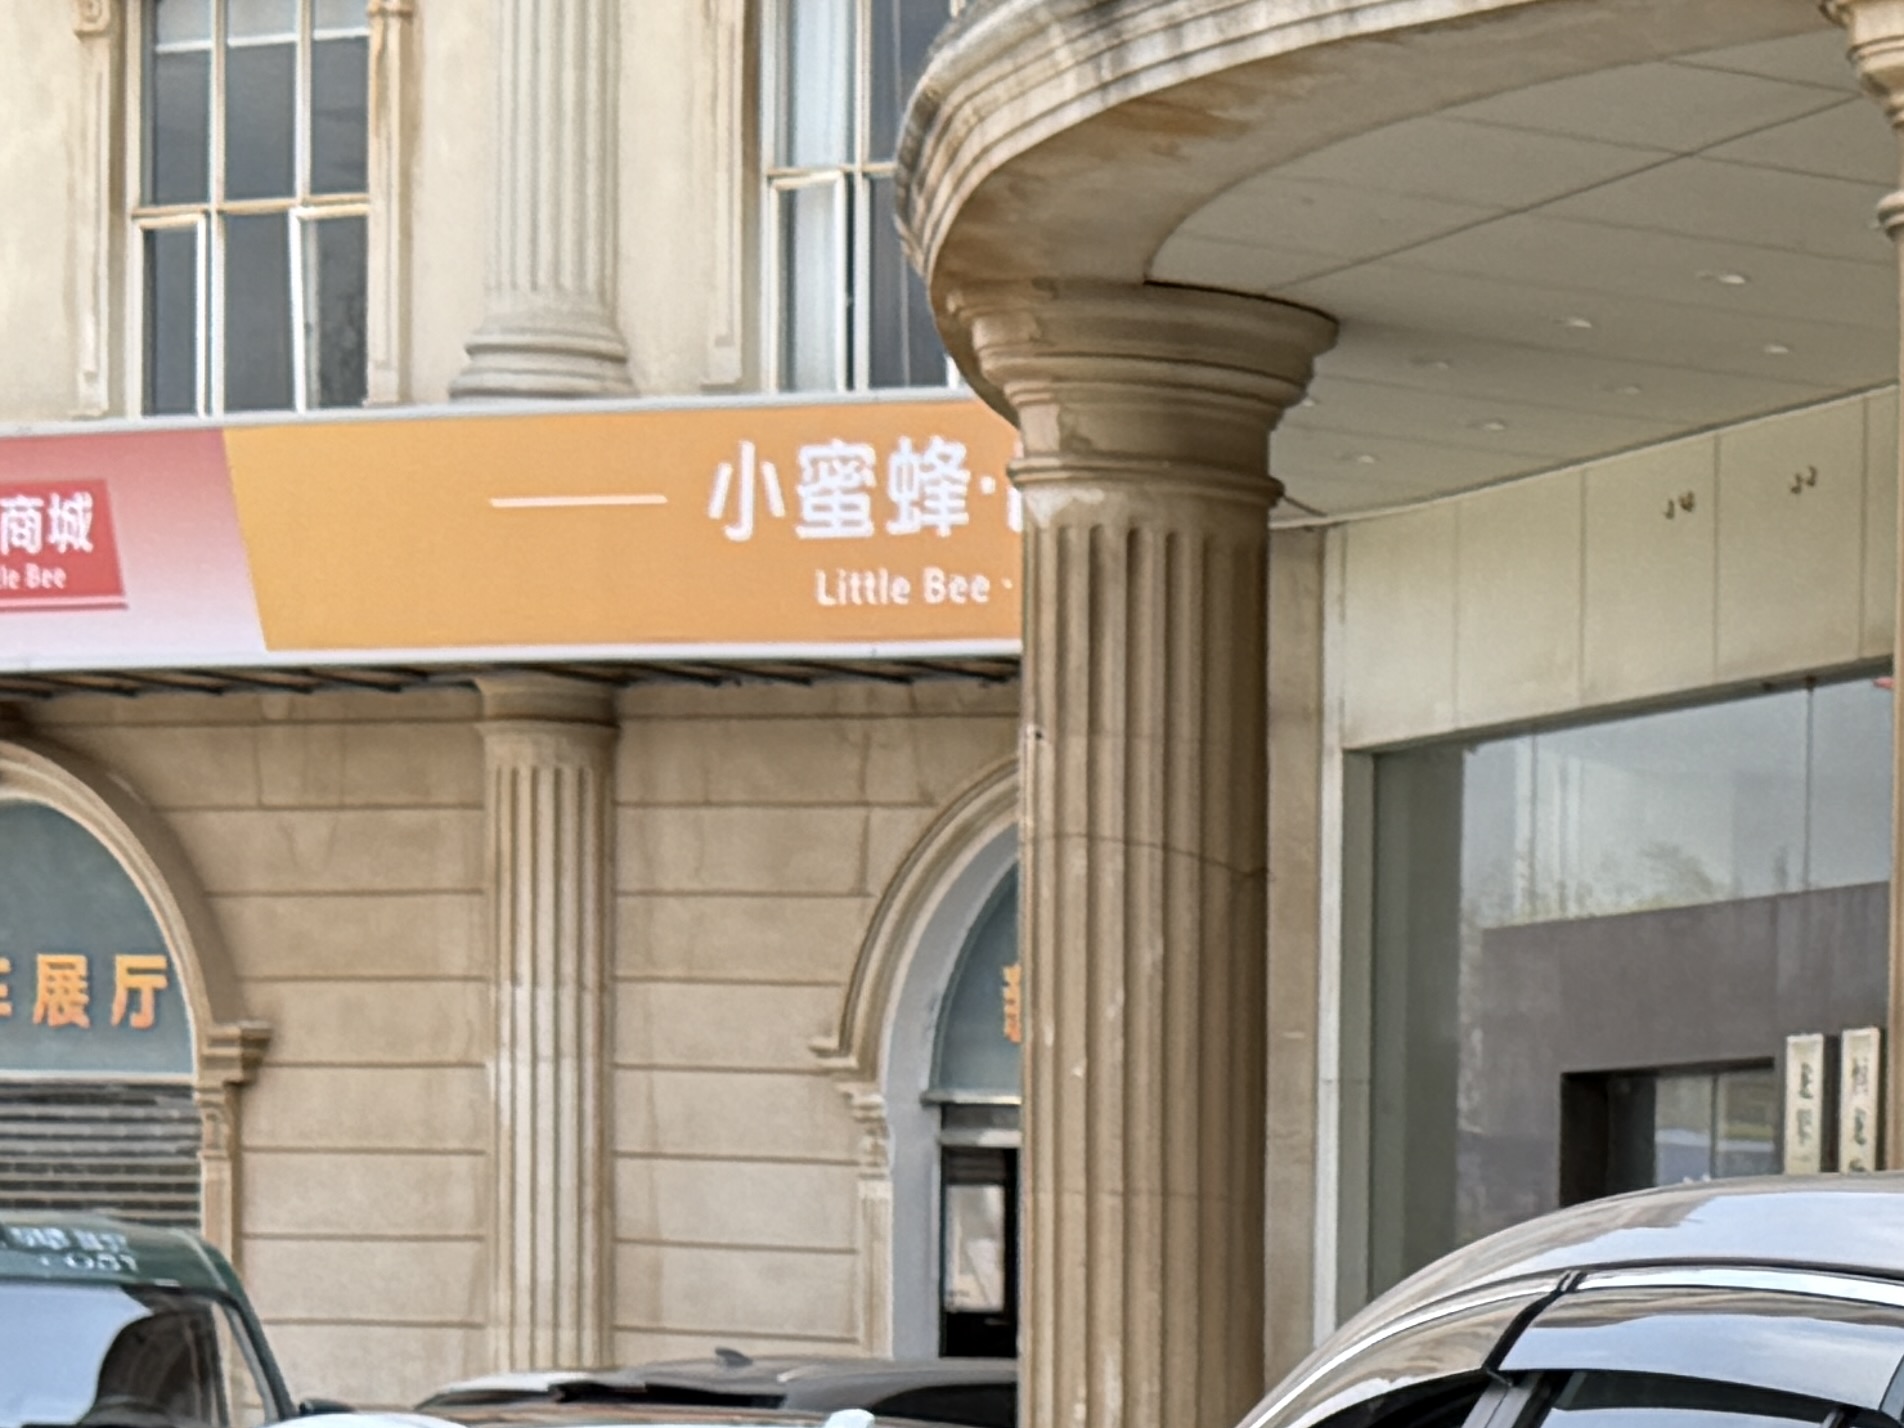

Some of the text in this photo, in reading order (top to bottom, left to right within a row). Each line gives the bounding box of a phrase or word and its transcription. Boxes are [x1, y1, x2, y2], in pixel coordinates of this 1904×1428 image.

[26, 563, 67, 589] Bee
[815, 565, 991, 606] Little Bee
[0, 954, 168, 1029] 展厅
